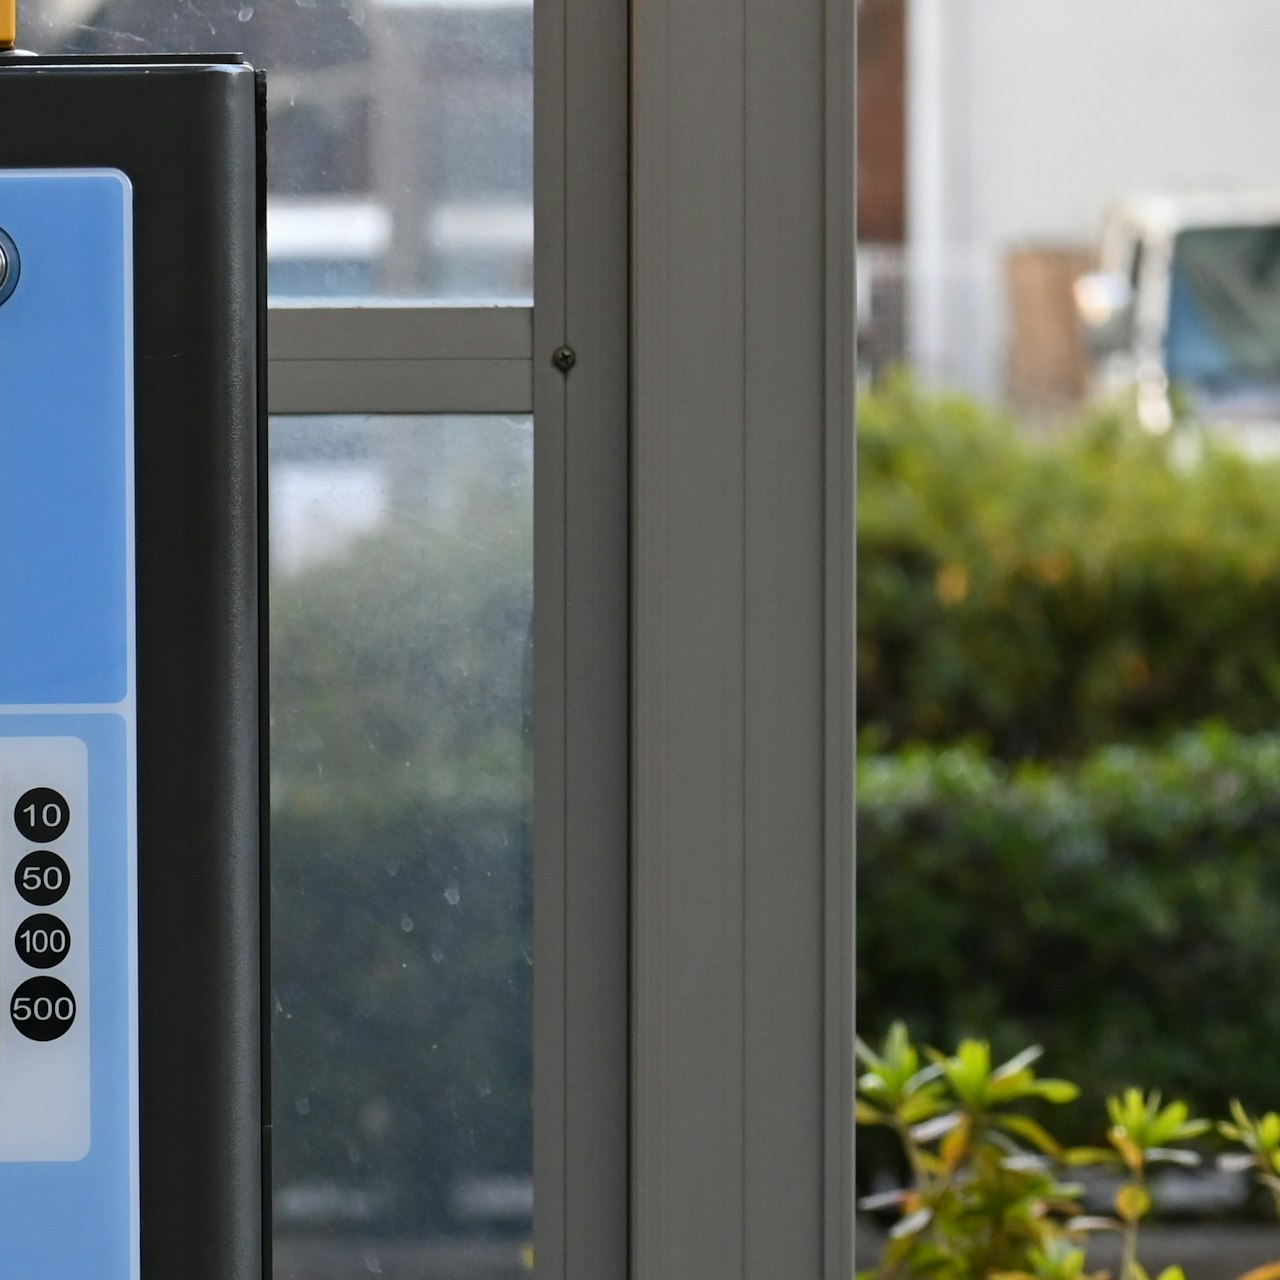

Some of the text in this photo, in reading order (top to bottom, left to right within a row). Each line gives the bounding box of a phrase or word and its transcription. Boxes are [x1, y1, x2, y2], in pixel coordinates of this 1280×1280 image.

[22, 803, 62, 828] 10
[22, 865, 63, 891] 50
[20, 929, 66, 954] 100
[12, 996, 74, 1022] 500
